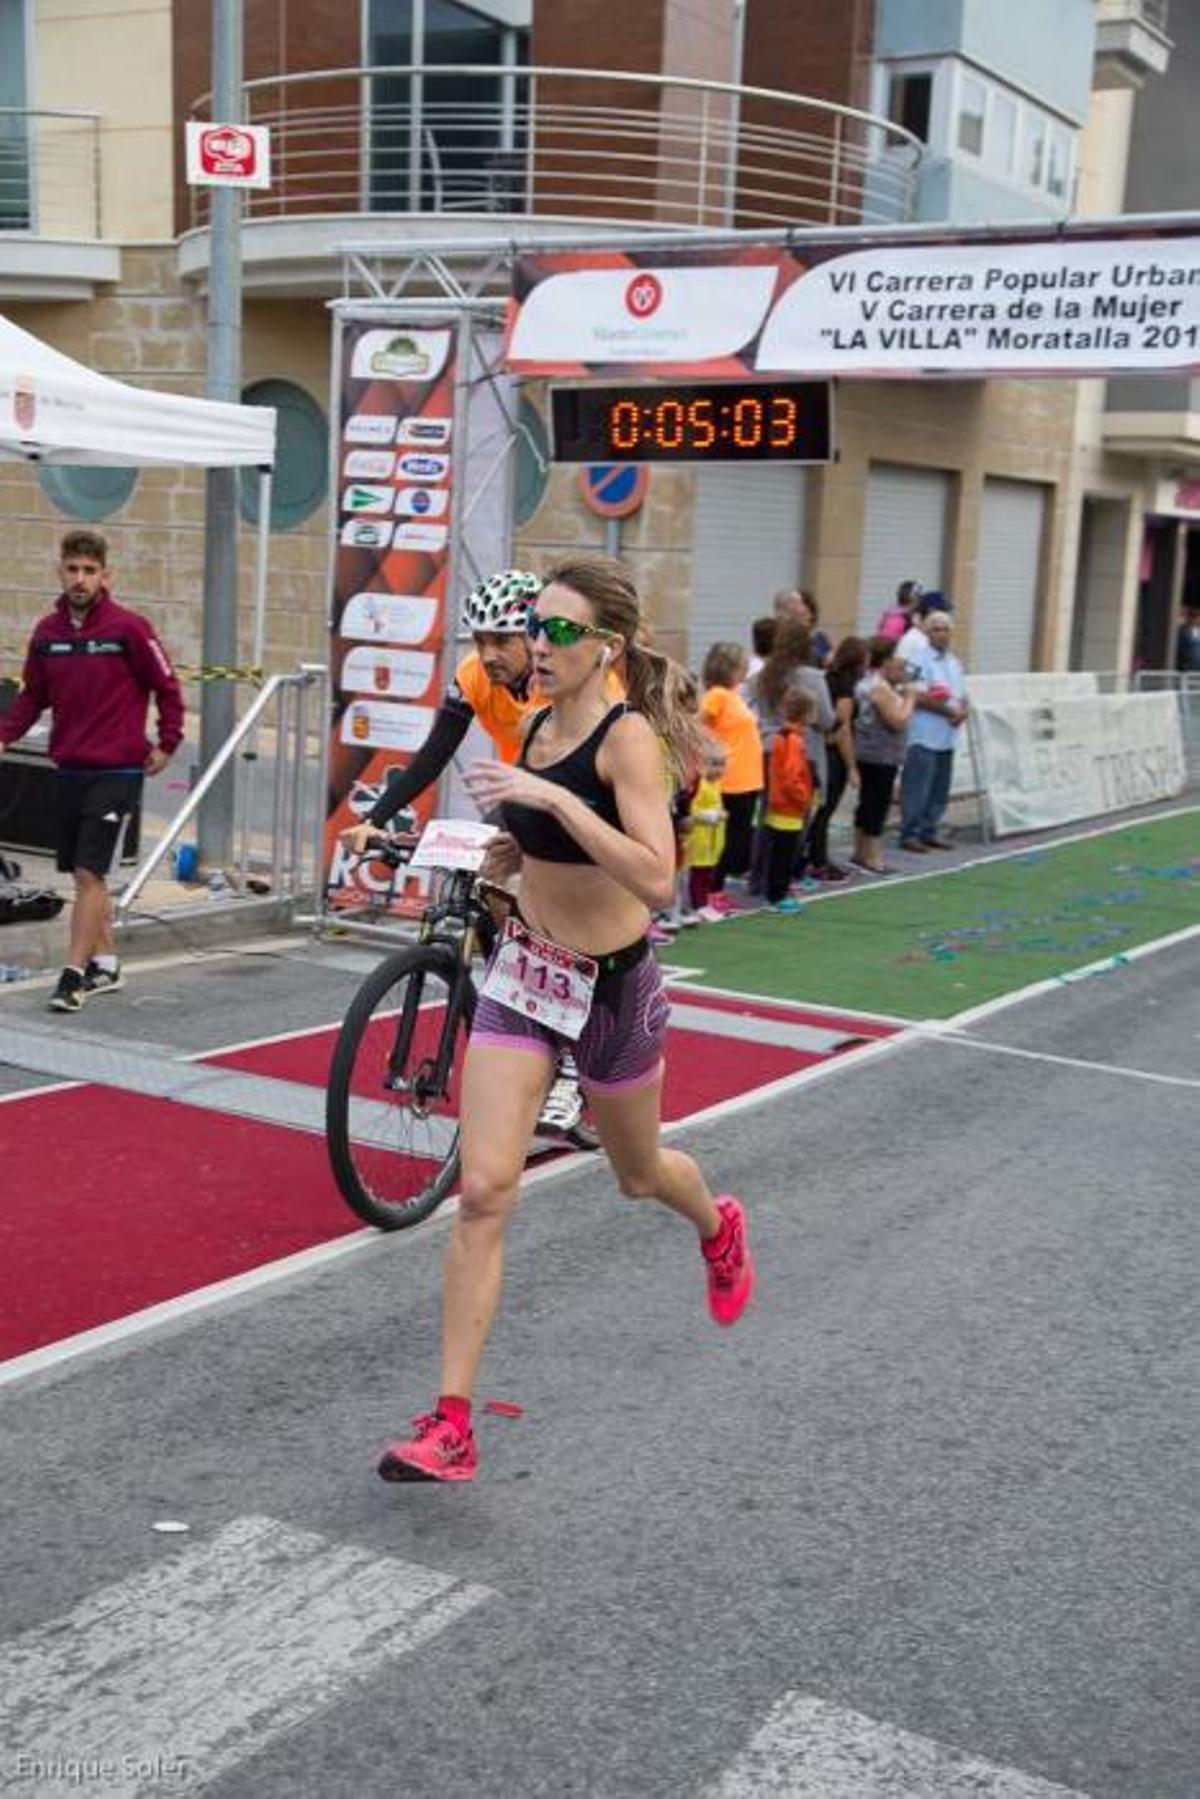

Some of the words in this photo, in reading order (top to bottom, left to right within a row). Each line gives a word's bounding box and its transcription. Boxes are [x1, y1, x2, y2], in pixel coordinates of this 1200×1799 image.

[829, 271, 857, 293] VI
[866, 270, 974, 293] Carrera
[984, 266, 1101, 295] Popular
[861, 300, 879, 321] V
[888, 299, 997, 321] Carrera
[1007, 297, 1044, 320] de
[1054, 297, 1081, 319] la
[1092, 294, 1183, 324] Mujer
[821, 328, 867, 350] "LA
[879, 327, 977, 350] VILLA"
[986, 327, 1131, 350] Moratalla
[612, 398, 797, 448] 0:05:03
[516, 953, 572, 1001] 113
